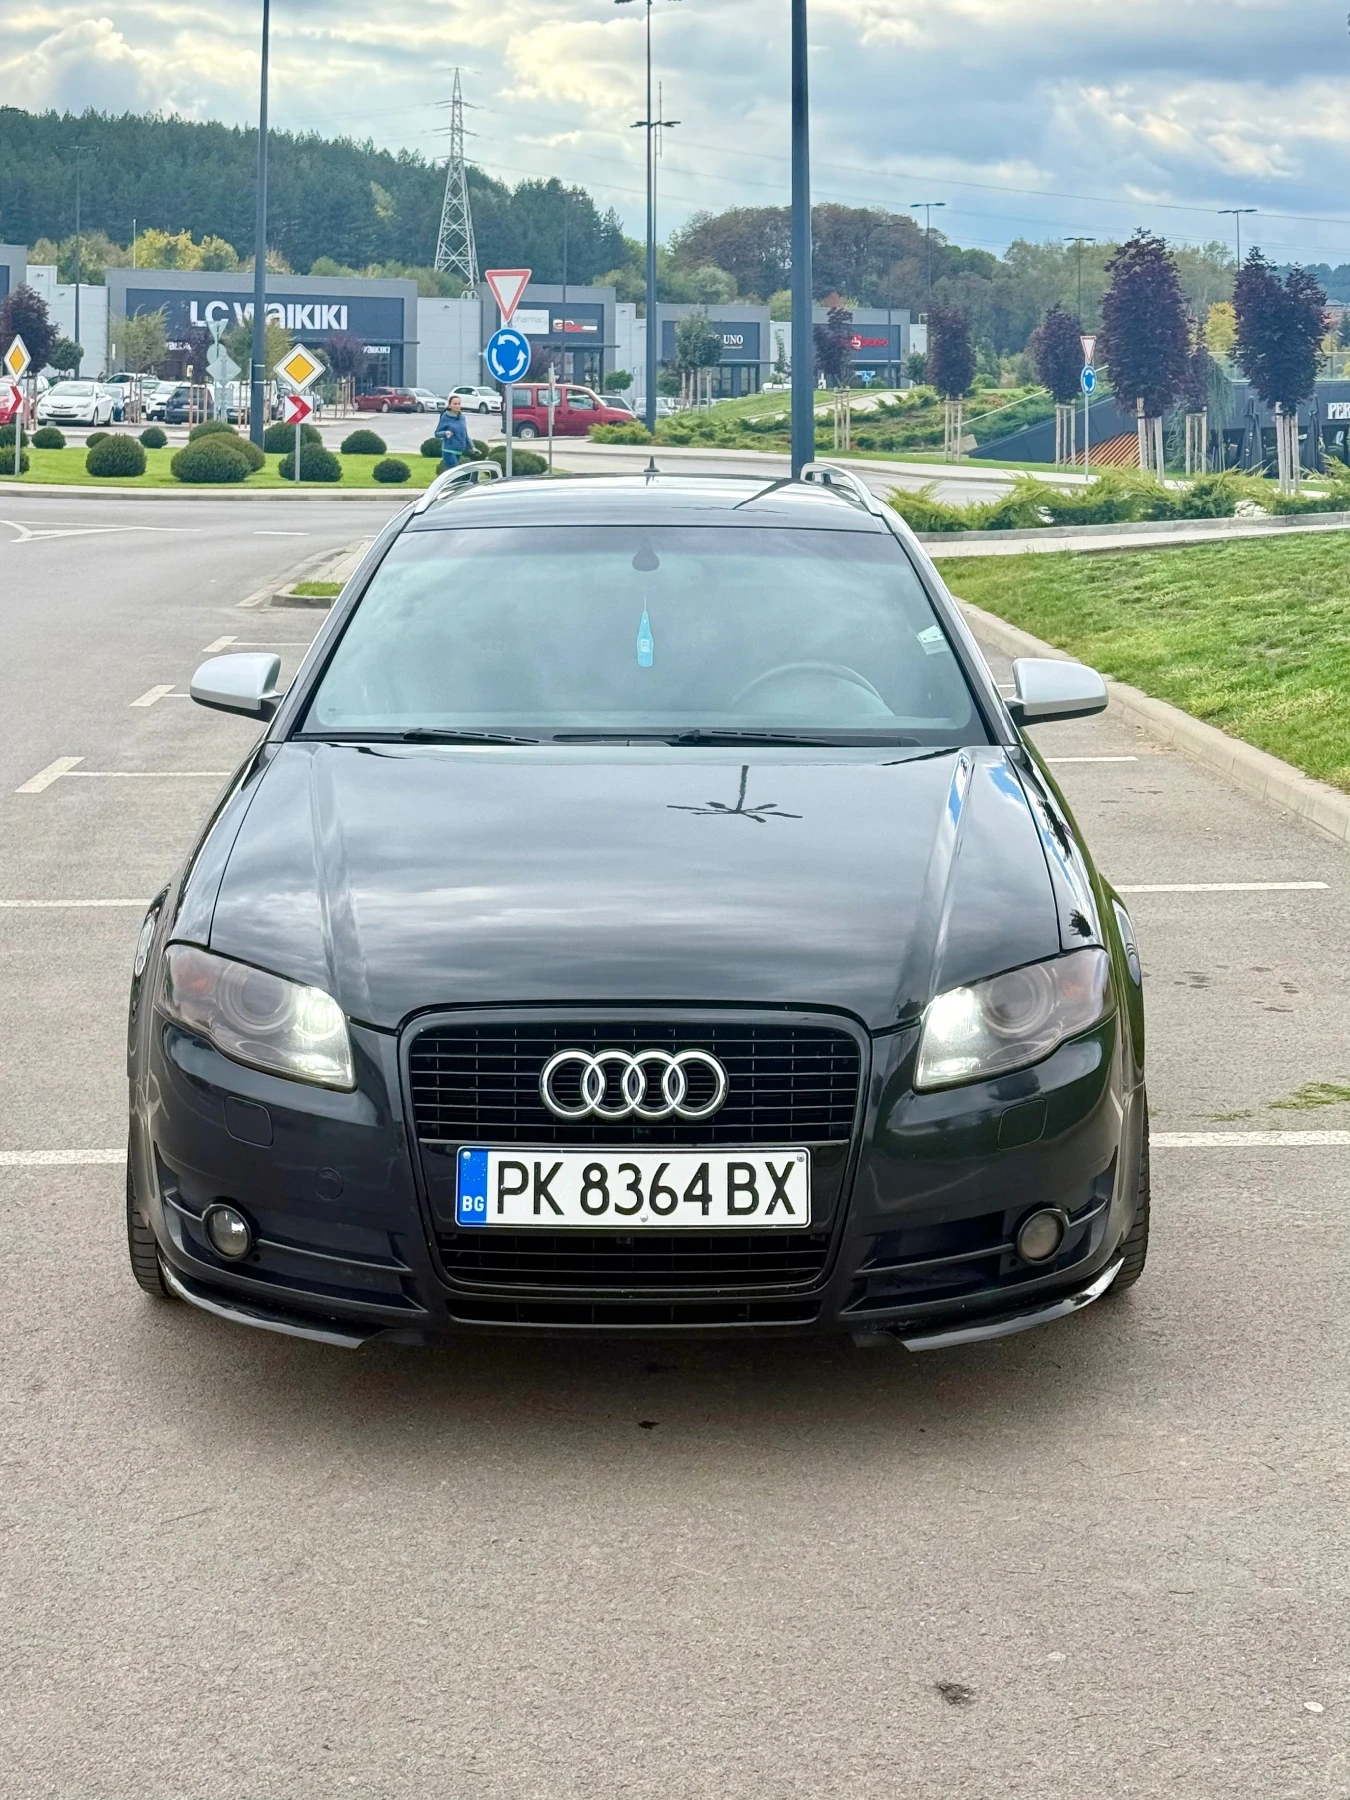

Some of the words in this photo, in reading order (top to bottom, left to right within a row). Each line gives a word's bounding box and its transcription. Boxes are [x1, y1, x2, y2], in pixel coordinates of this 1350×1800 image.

[190, 301, 229, 328] LC
[723, 334, 744, 345] UNO
[1327, 402, 1350, 420] PER
[497, 1160, 565, 1216] PK
[579, 1162, 713, 1216] 8364
[727, 1161, 796, 1216] BX
[462, 1195, 485, 1212] BG
